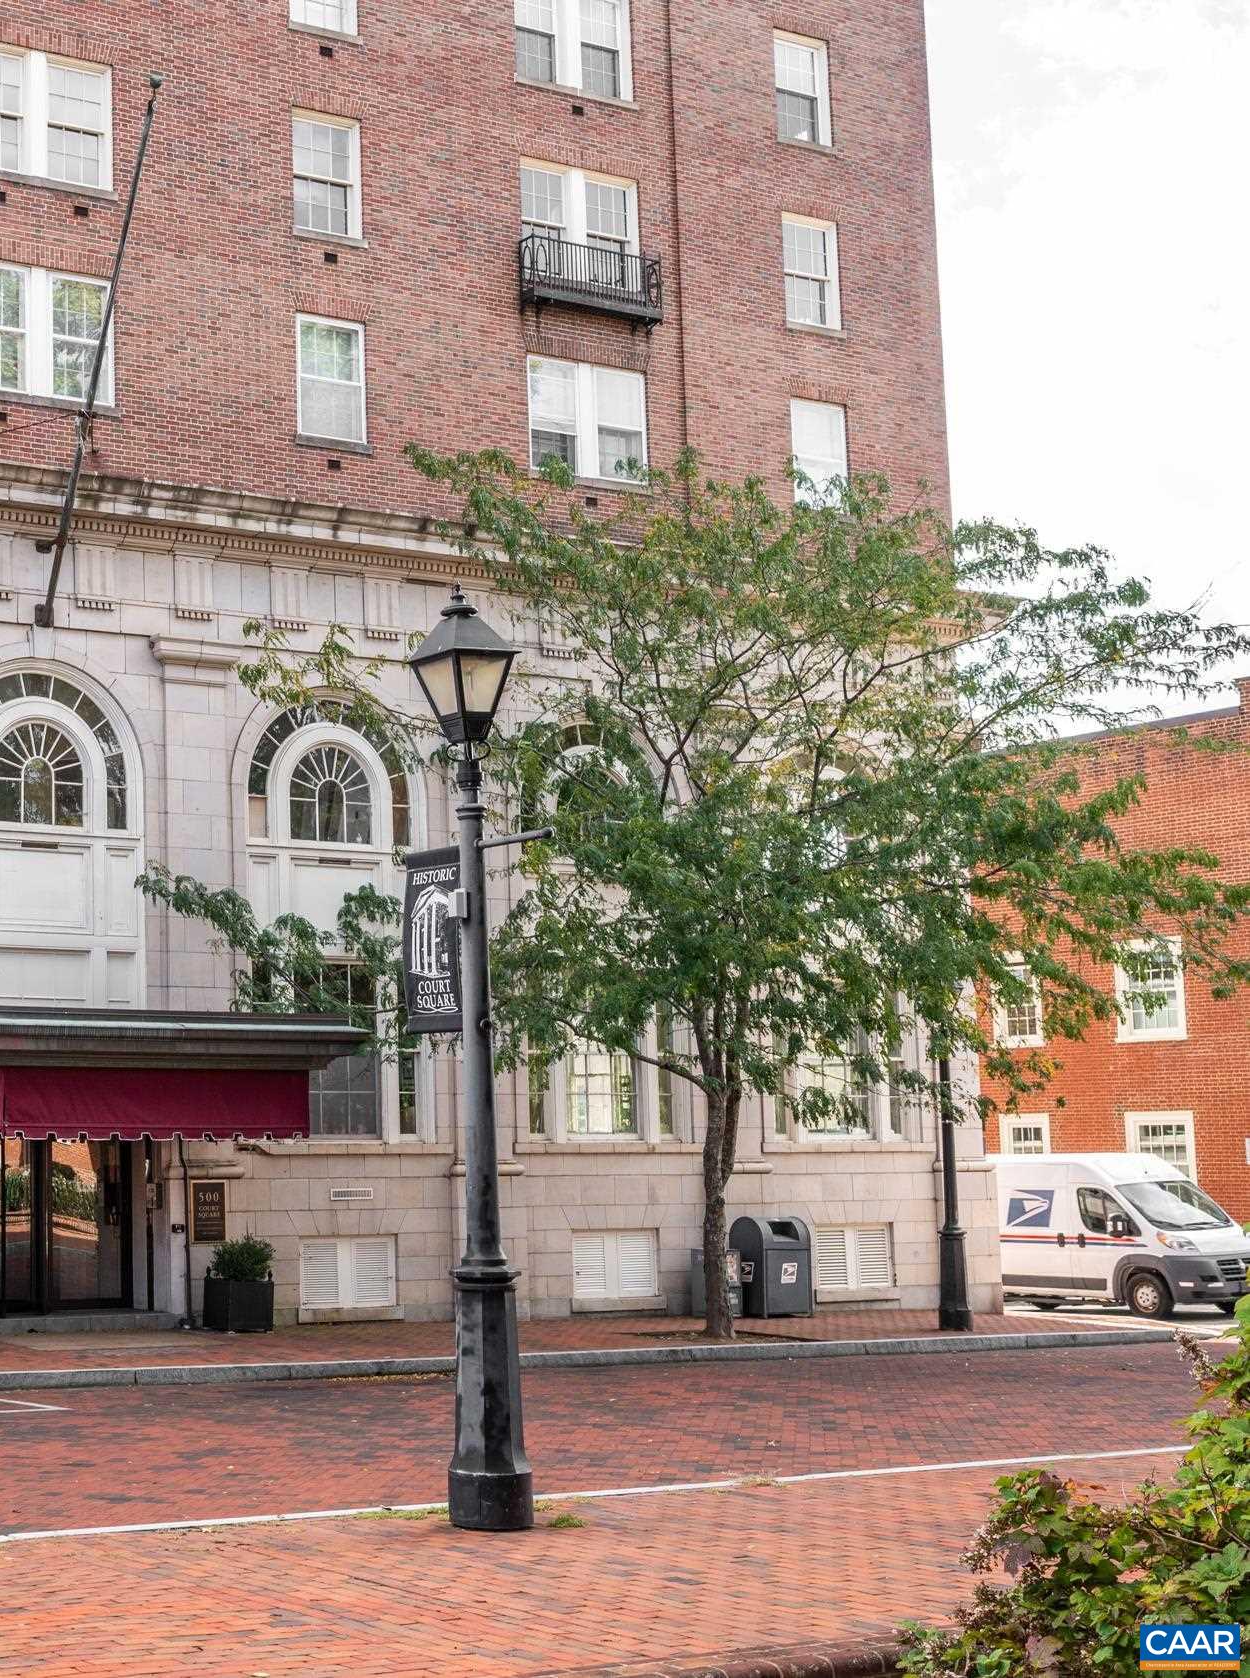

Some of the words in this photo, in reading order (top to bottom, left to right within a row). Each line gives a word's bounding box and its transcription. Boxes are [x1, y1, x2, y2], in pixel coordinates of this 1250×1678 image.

[412, 867, 457, 885] HISTORIC
[418, 979, 451, 994] COURT
[417, 993, 456, 1009] SQUARE
[198, 1191, 220, 1202] 500
